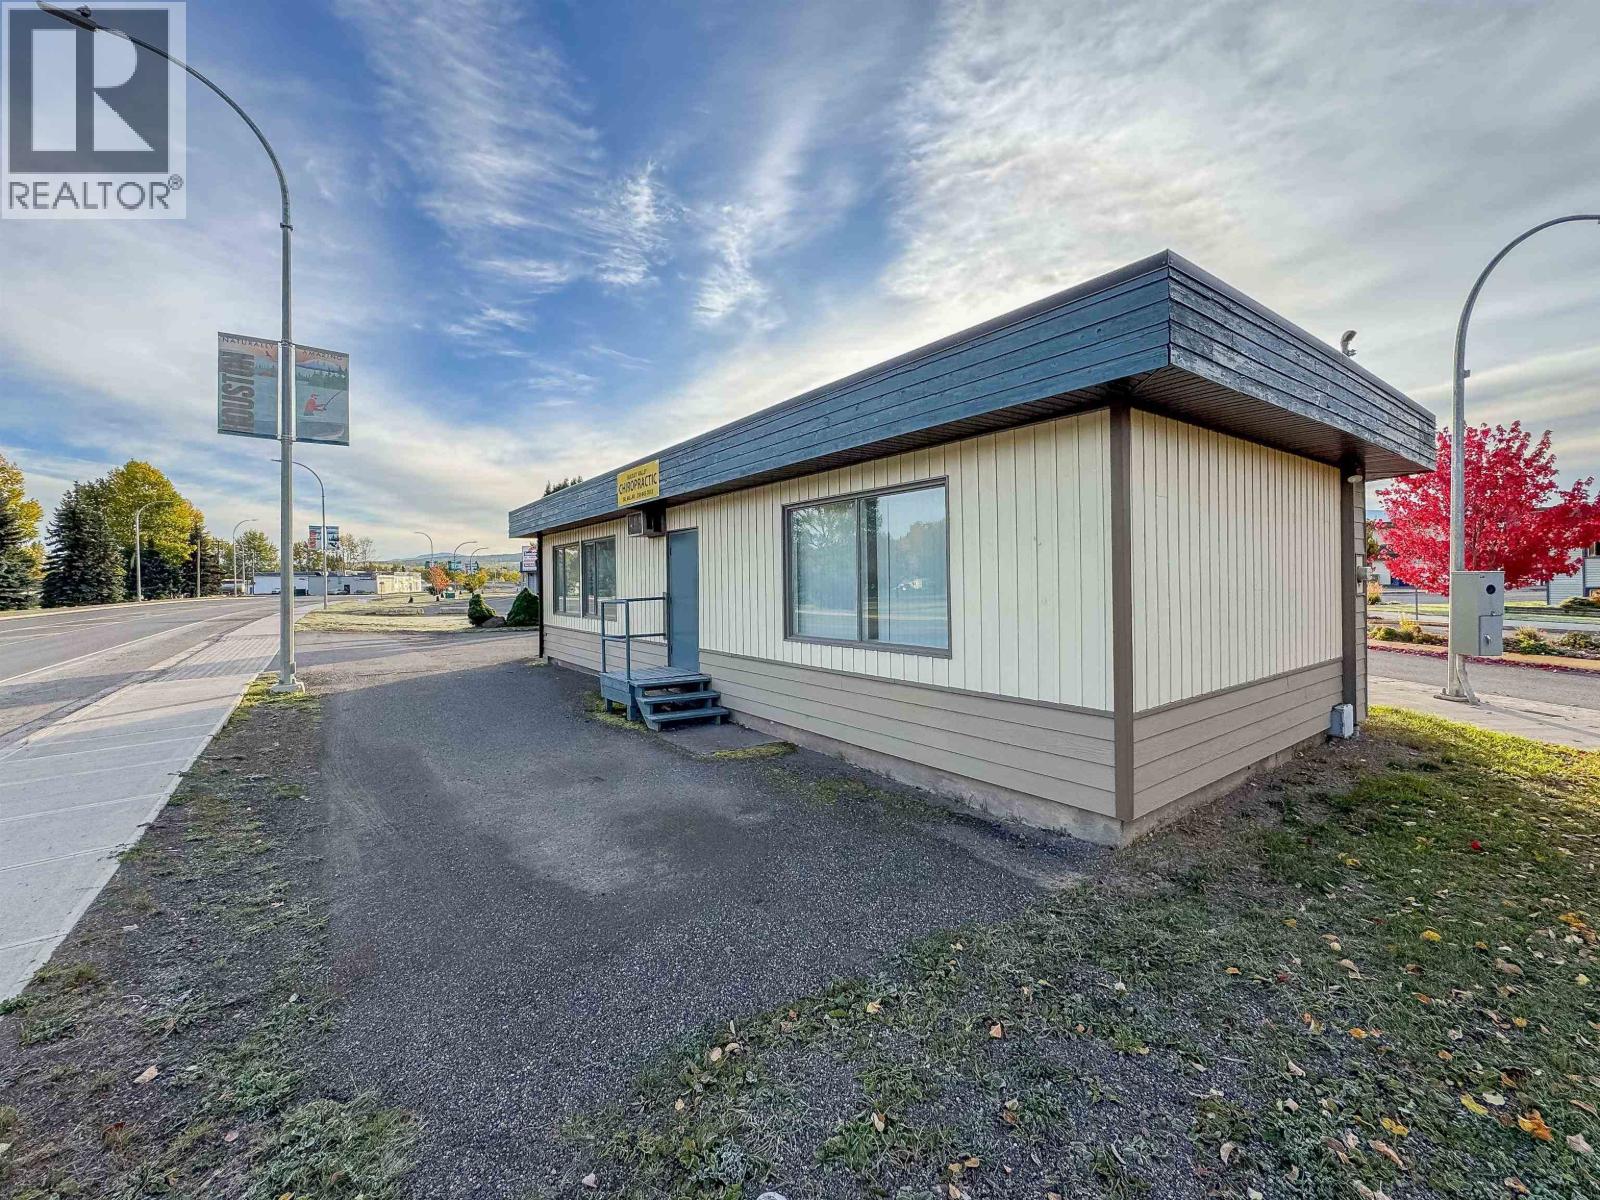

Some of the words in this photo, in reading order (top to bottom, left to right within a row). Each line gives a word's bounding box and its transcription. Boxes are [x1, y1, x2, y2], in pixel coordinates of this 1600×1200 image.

[222, 337, 274, 349] NATURALLY
[302, 351, 343, 361] AMAZING
[222, 351, 255, 432] HOUSTON
[618, 473, 657, 494] CHIROPRACTIC
